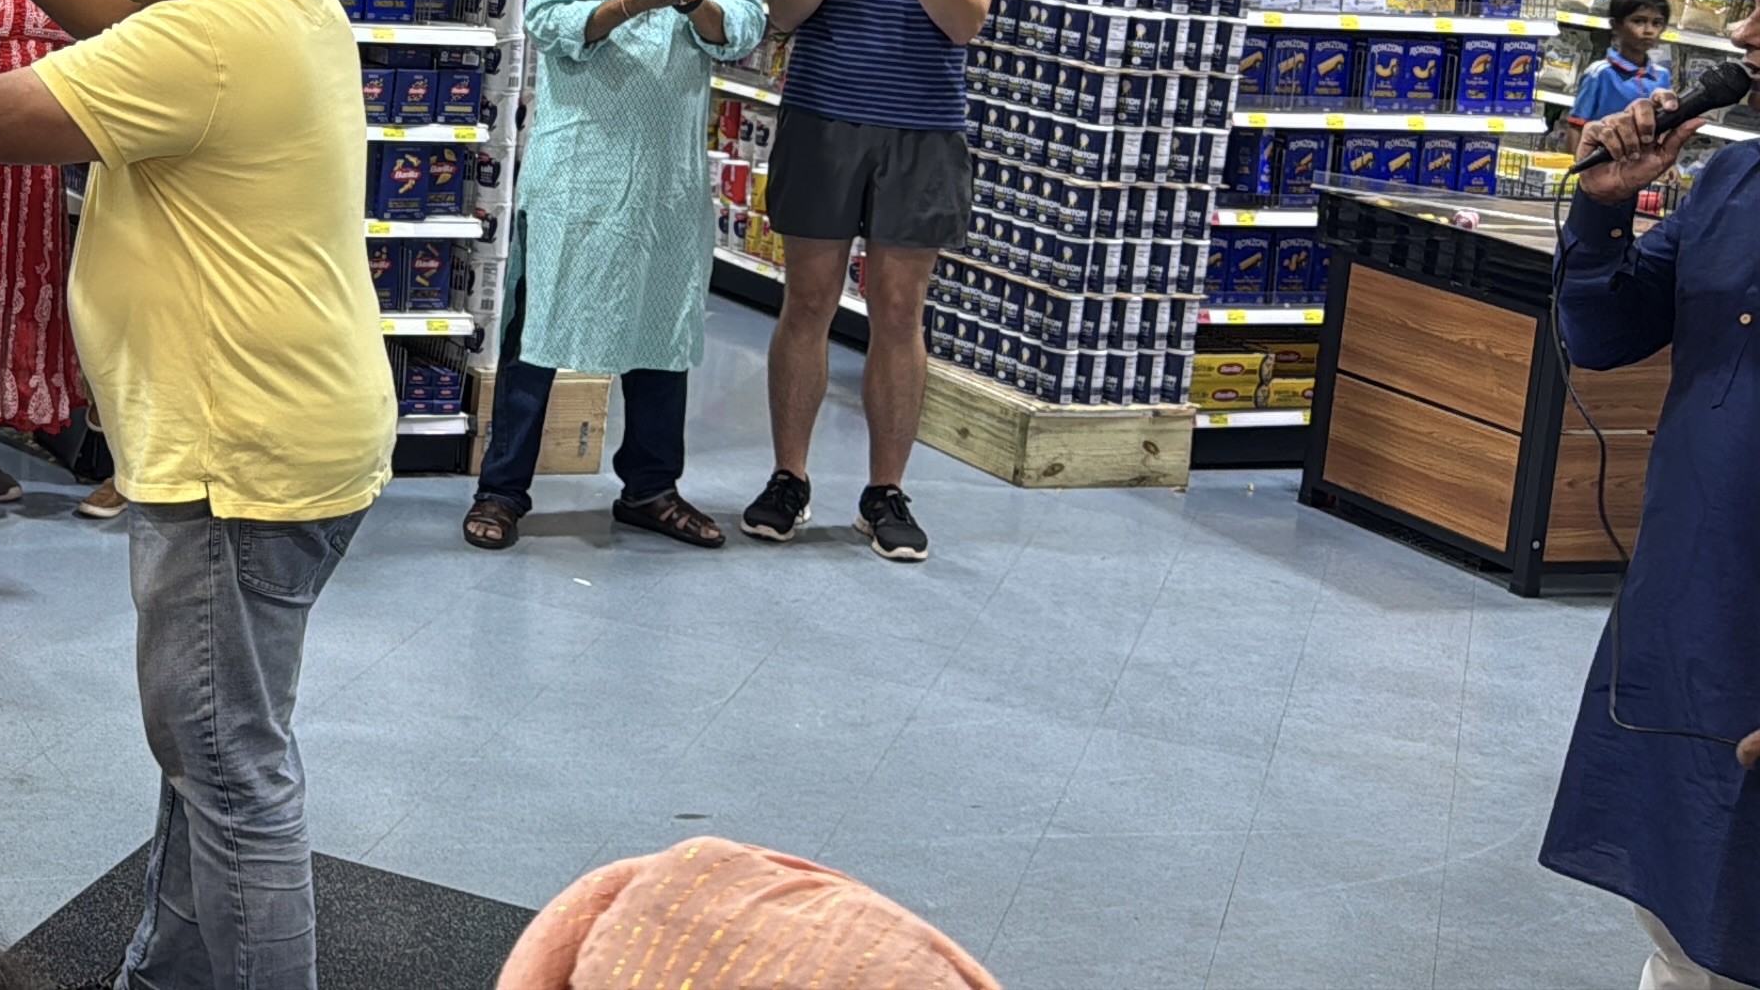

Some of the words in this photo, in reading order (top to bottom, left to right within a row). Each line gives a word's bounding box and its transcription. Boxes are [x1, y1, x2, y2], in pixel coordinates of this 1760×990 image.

[1276, 39, 1309, 51] RONZONI
[1315, 40, 1348, 52] RONZONI
[1370, 42, 1404, 55] RONZONI
[1409, 44, 1441, 56] RONZONI
[1465, 39, 1497, 51] RONZONI
[1503, 40, 1536, 52] RONZONI
[1289, 139, 1319, 150] RONZONI
[1346, 138, 1379, 150] RONZONI
[1384, 139, 1417, 150] RONZONI
[1424, 140, 1457, 151] RONZONI
[1465, 140, 1497, 152] RONZONI
[394, 169, 419, 180] Barilla
[1234, 239, 1269, 249] RONZONI
[1280, 238, 1313, 249] RONZONI
[415, 260, 440, 269] Barilla
